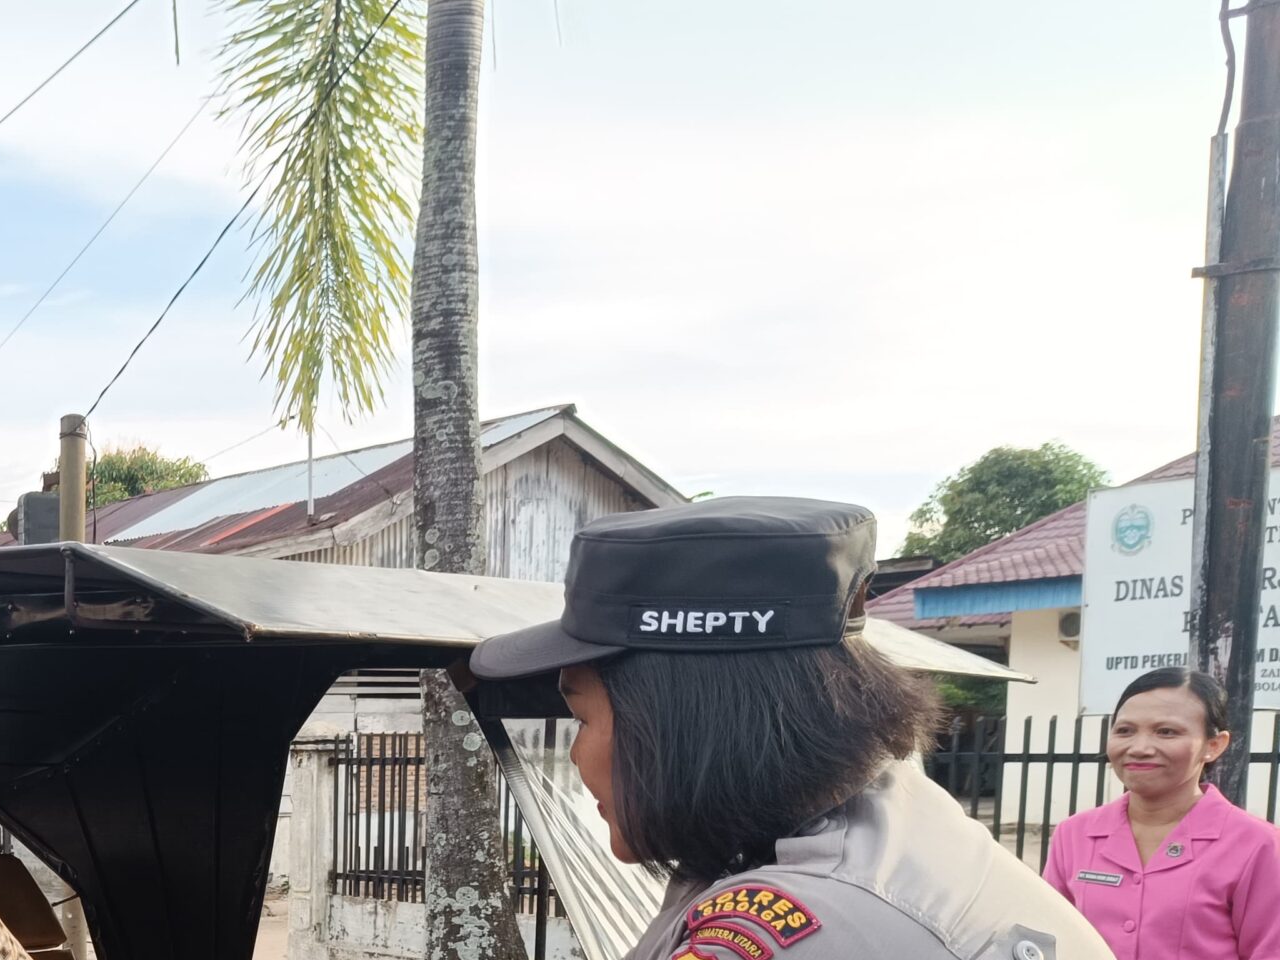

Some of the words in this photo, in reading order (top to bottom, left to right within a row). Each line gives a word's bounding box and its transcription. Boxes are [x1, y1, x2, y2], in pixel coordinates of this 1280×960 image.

[1114, 575, 1183, 602] DINAS
[639, 610, 774, 633] SHEPTY
[1106, 656, 1138, 670] UPTD
[703, 901, 786, 931] SIBOLGA
[697, 927, 734, 941] SUMATERA
[734, 932, 762, 958] UTARA
